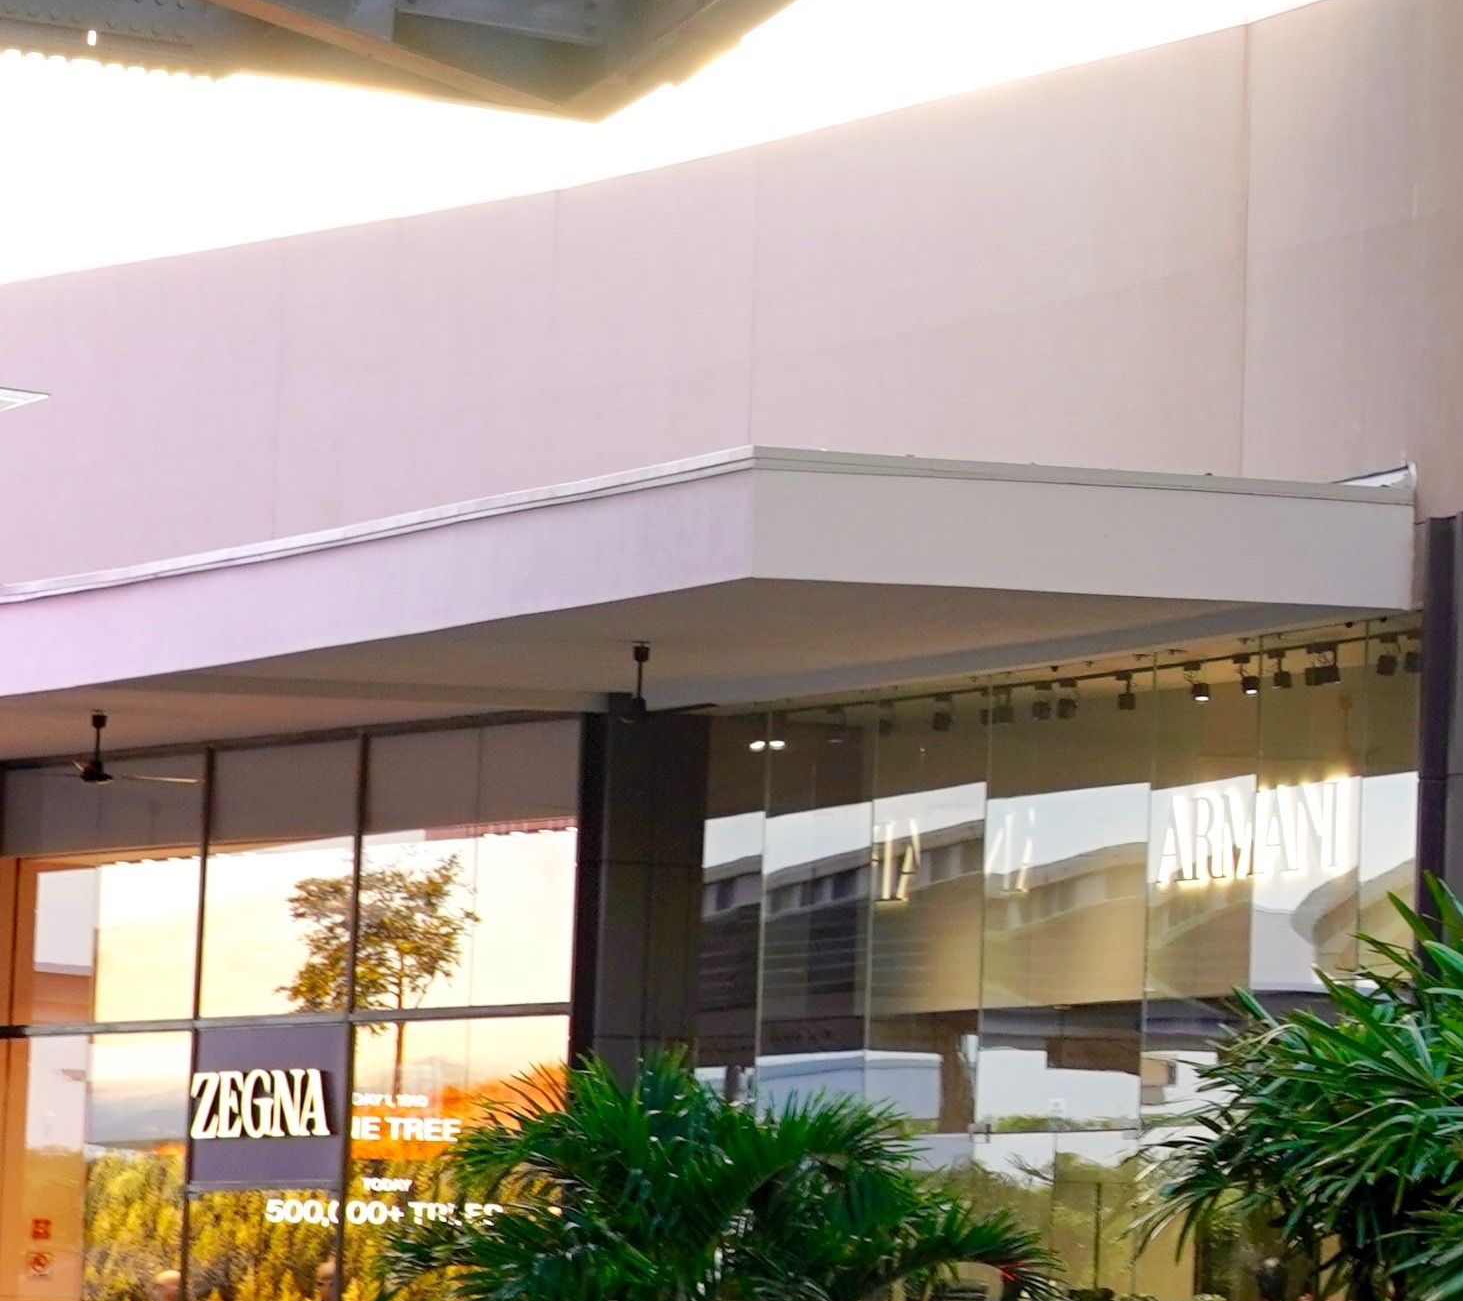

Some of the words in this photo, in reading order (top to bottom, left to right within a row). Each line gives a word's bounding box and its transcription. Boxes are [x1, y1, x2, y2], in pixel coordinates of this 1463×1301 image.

[1154, 778, 1341, 885] ARMANI
[190, 1068, 332, 1140] ZEGNA
[384, 1116, 462, 1142] TREE
[362, 1177, 413, 1192] TODAY
